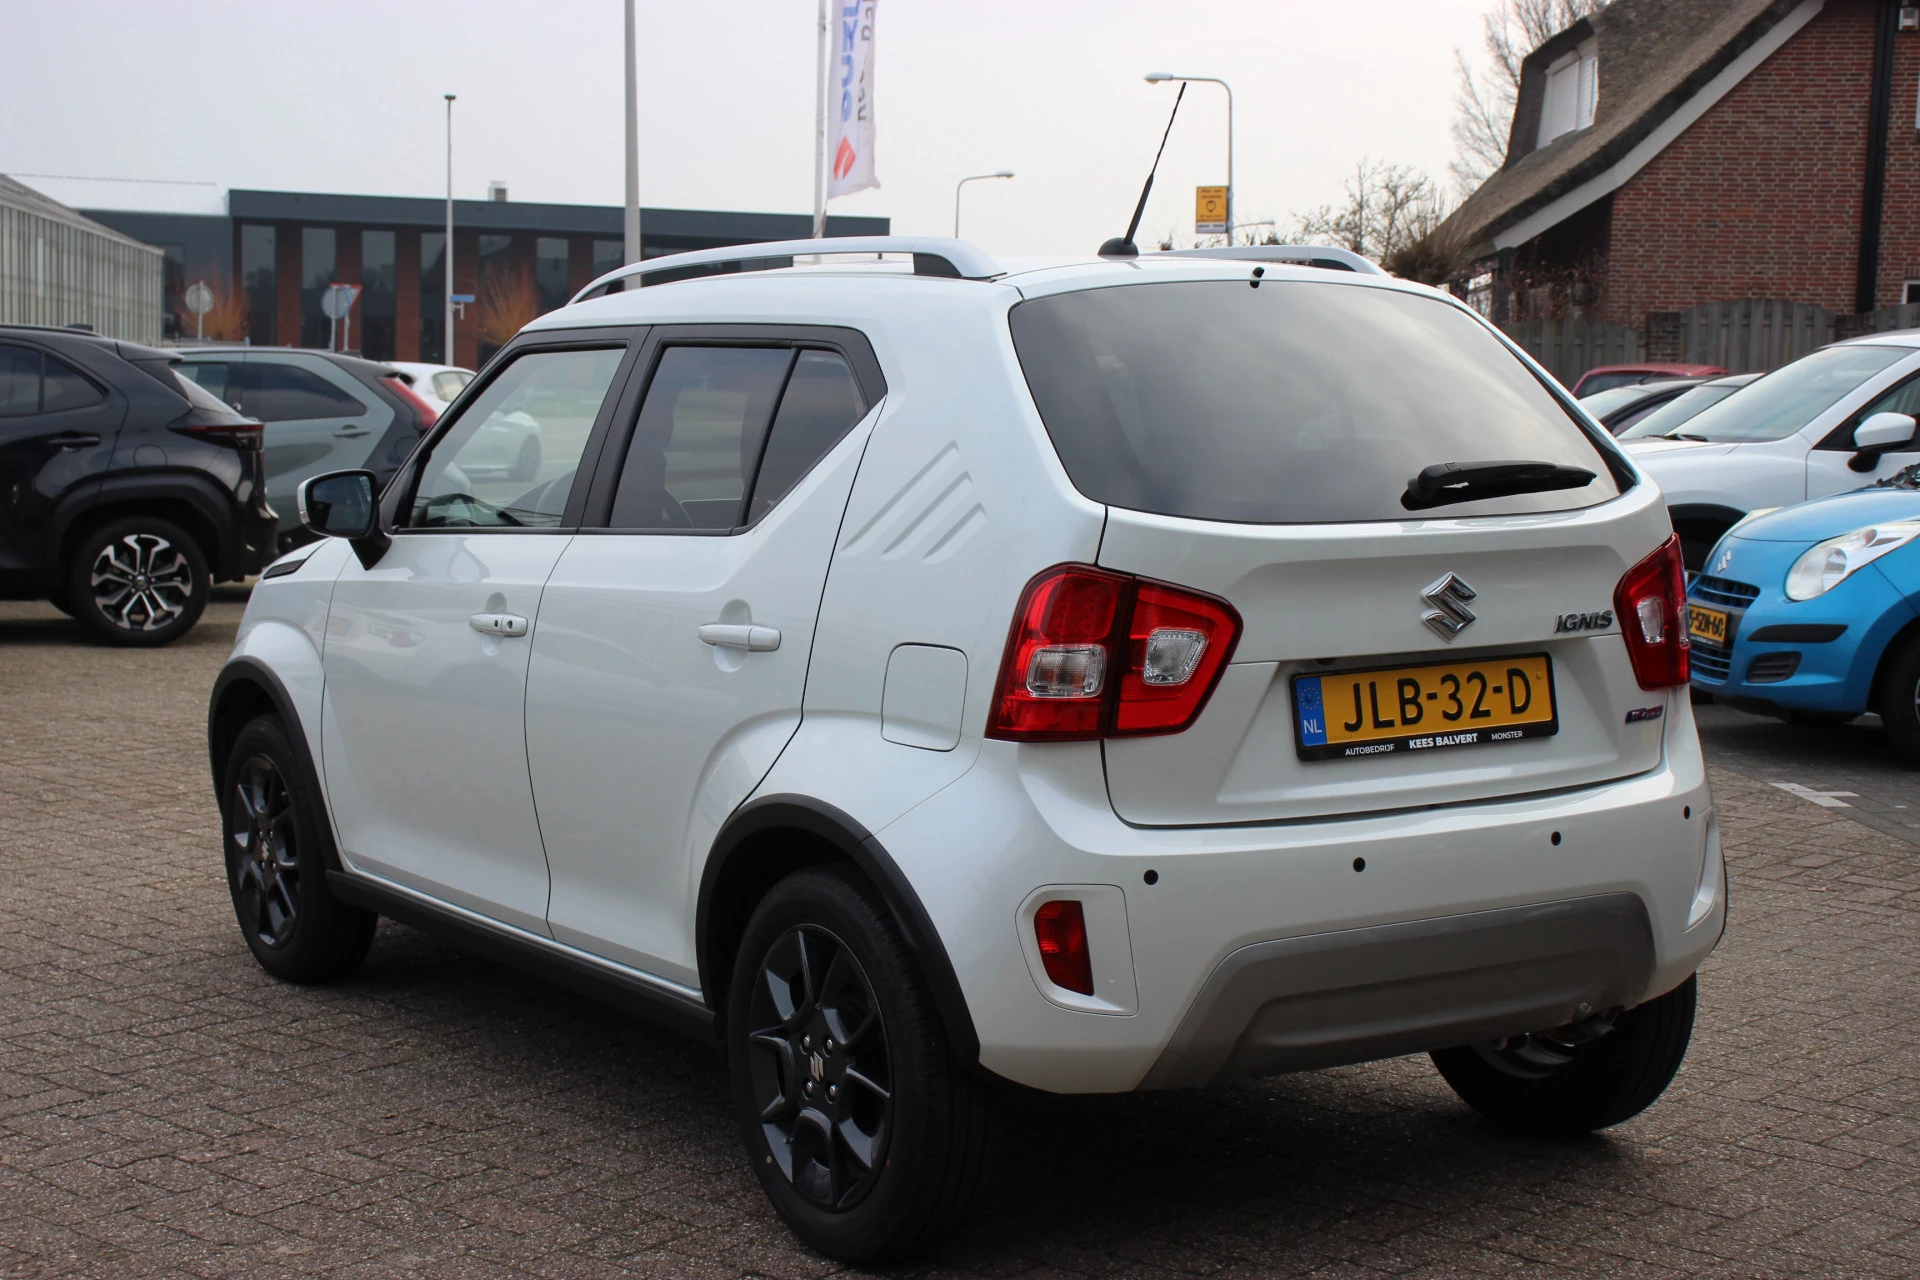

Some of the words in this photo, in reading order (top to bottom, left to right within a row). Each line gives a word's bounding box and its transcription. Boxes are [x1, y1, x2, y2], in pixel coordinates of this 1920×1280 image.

[1553, 609, 1613, 633] IGNIS
[1343, 667, 1532, 733] JLB-32-D
[1303, 718, 1323, 735] NL
[1345, 743, 1395, 756] AUTOBEDRIJF
[1409, 737, 1434, 749] KEES
[1435, 733, 1478, 746] BALVERT
[1491, 730, 1523, 740] MONSTER
